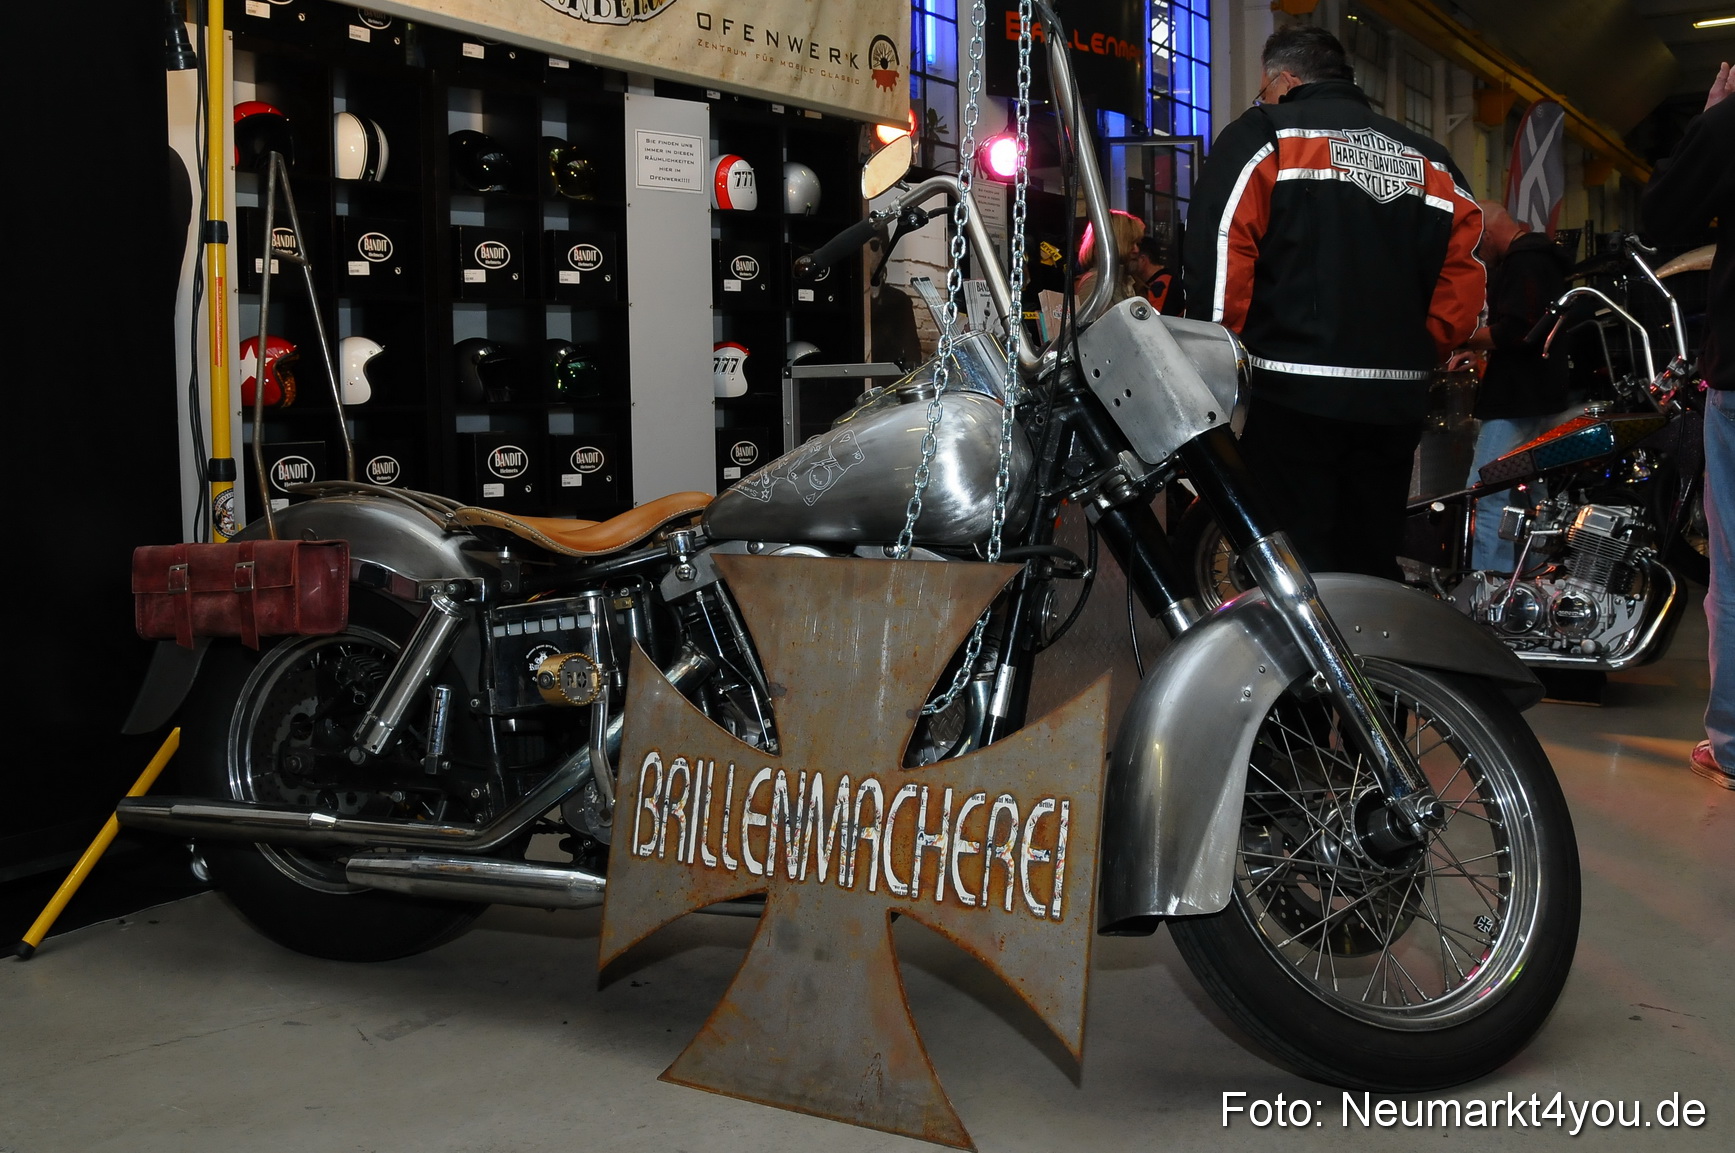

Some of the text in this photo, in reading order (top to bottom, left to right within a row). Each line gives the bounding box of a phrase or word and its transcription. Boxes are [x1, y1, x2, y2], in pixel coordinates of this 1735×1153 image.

[696, 12, 859, 70] OFENWERK
[697, 38, 747, 57] ZENTRUM
[1352, 132, 1396, 154] MOTOR
[1335, 145, 1418, 178] HARLEY-DAVIDSON
[733, 170, 753, 189] 777
[1357, 171, 1400, 198] CYCLES
[364, 237, 388, 252] BANDIT
[481, 245, 505, 260] BANDIT
[574, 248, 597, 262] BANDIT
[735, 260, 755, 272] BANDIT
[713, 356, 740, 375] 777
[495, 452, 522, 468] BANDIT
[576, 452, 599, 464] BANDIT
[735, 446, 754, 458] BANDIT
[278, 462, 308, 481] BANDIT
[372, 461, 395, 475] BANDIT
[633, 751, 1069, 919] BRILLENMACHEREI
